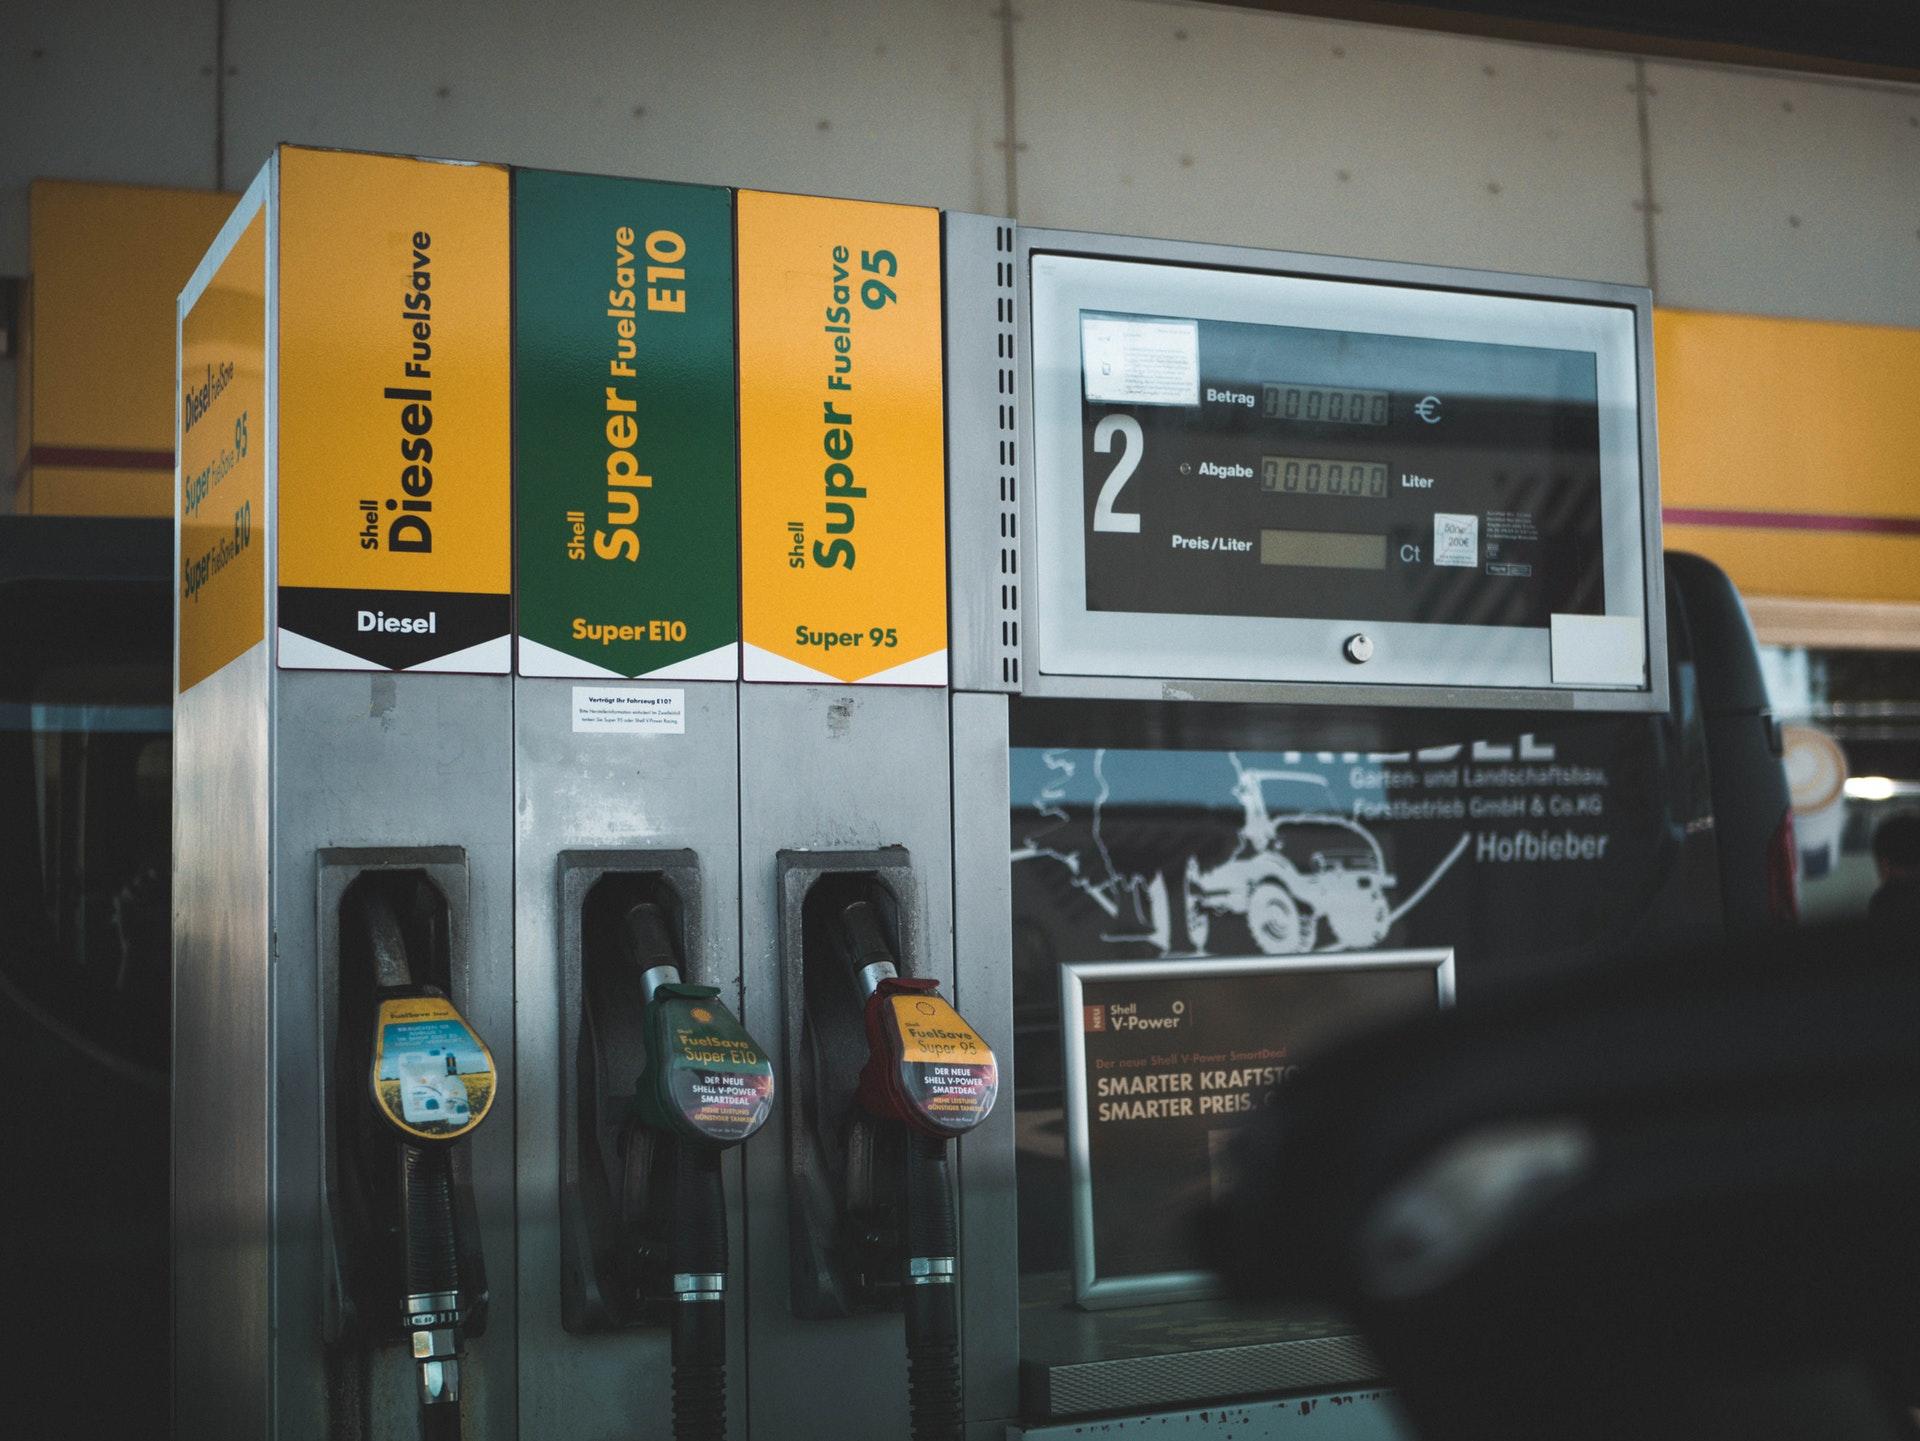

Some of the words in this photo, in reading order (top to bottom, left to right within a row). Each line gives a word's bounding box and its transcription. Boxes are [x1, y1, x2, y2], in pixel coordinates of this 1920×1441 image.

[646, 230, 686, 313] E10
[861, 249, 898, 311] 95
[402, 231, 431, 378] FuelSave
[608, 226, 636, 377] FuelSave
[825, 245, 852, 391] FuelSave
[186, 363, 212, 433] Diesel
[1207, 389, 1256, 408] Betrag
[184, 464, 212, 519] Super
[235, 410, 248, 463] 95
[384, 387, 433, 553] Diesel
[594, 387, 652, 562] Super
[1094, 414, 1144, 534] 2
[1199, 462, 1254, 478] Abgabe
[813, 401, 867, 571] Super
[1402, 474, 1434, 488] Liter
[360, 499, 378, 550] Shell
[567, 510, 585, 560] Shell
[184, 548, 212, 603] Super
[234, 499, 250, 555] E10
[788, 522, 804, 569] Shell
[1400, 544, 1420, 562] Ct
[358, 610, 436, 634] Diesel
[572, 618, 646, 646] Super
[649, 620, 686, 642] E10
[795, 625, 864, 651] Super
[869, 628, 898, 648] 95
[1424, 768, 1457, 787] und
[1354, 798, 1466, 820] Forstbetrieb
[1470, 798, 1526, 818] GmbH
[1531, 798, 1545, 816] &
[1476, 830, 1608, 862] Hofbieber
[1094, 1008, 1102, 1029] NEU
[1110, 1004, 1136, 1015] Shell
[908, 1028, 973, 1040] FuelSave
[1112, 1016, 1180, 1031] V-Power
[680, 1035, 749, 1048] FuelSave
[918, 1040, 956, 1058] Super
[960, 1042, 977, 1056] 95
[684, 1048, 725, 1066] Super
[731, 1050, 758, 1064] E10
[1152, 1054, 1178, 1066] Shell
[1180, 1052, 1227, 1064] V-Power
[704, 1076, 720, 1085] DER
[722, 1077, 744, 1086] NEUE
[924, 1076, 946, 1084] SHELL
[948, 1078, 984, 1086] V-POWER
[934, 1067, 949, 1075] DER
[951, 1068, 971, 1076] NEUE
[692, 1085, 716, 1094] SHELL
[718, 1087, 758, 1096] V-POWER
[932, 1086, 977, 1095] SMARTDEAL
[1098, 1073, 1192, 1096] SMARTER
[701, 1094, 750, 1105] SMARTDEAL
[1098, 1098, 1193, 1122] SMARTER
